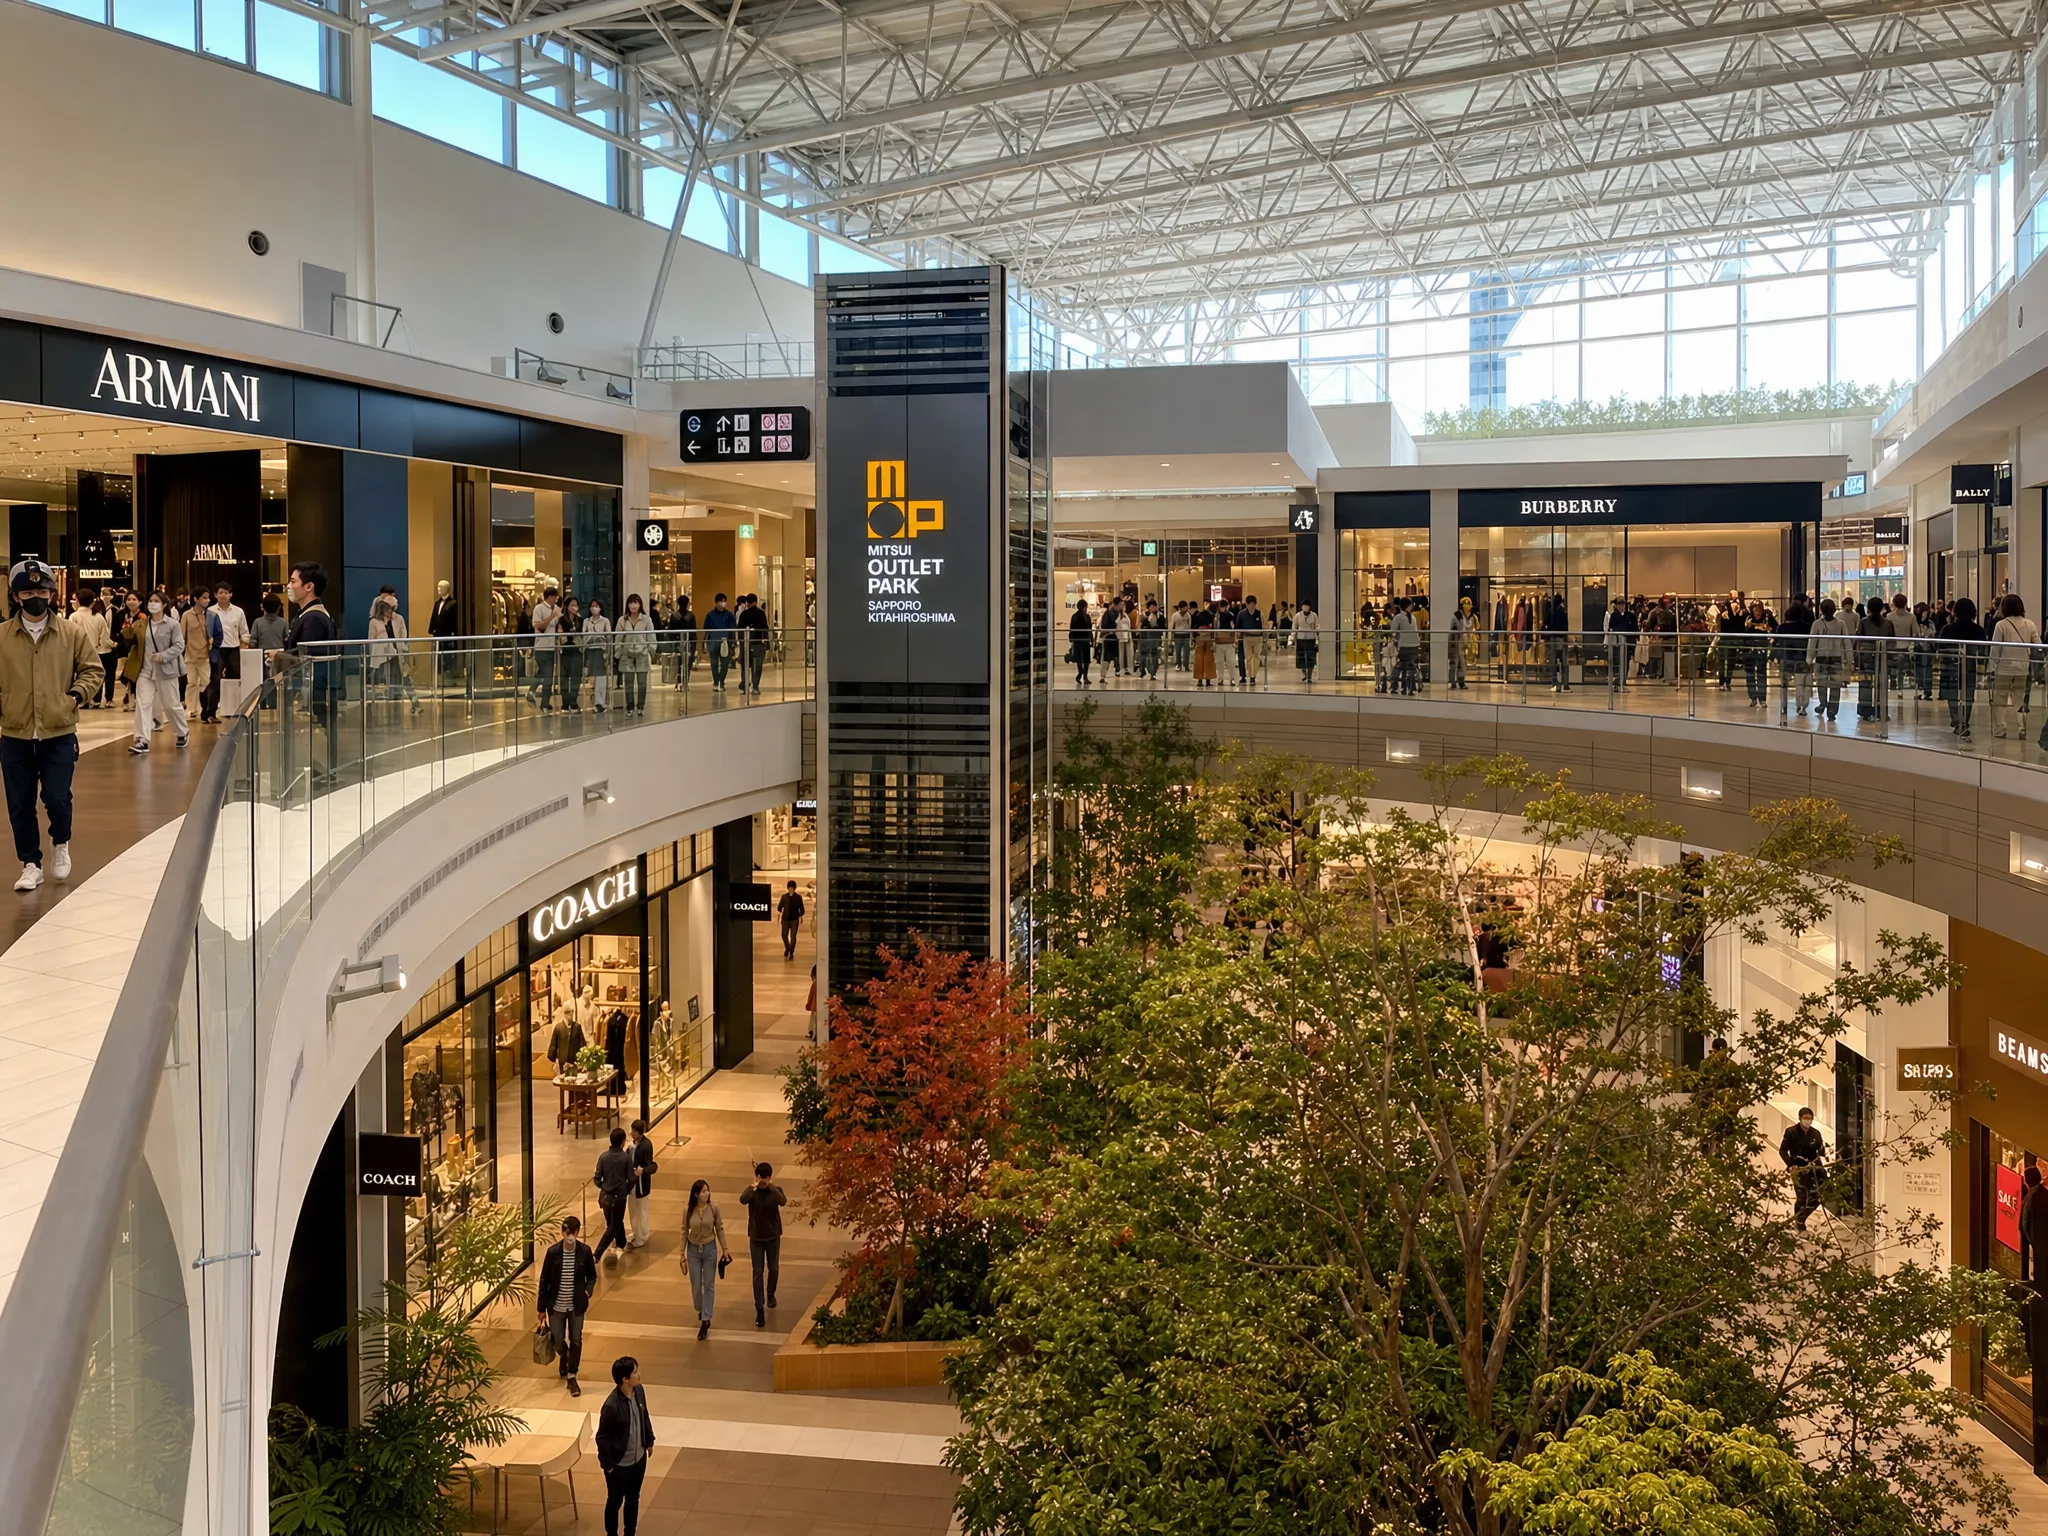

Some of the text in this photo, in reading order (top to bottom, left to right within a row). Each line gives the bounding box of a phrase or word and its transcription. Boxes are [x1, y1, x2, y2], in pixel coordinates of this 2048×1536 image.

[91, 346, 261, 422] ARMANI
[1955, 488, 1991, 497] BALLY
[1520, 499, 1618, 515] BURBERRY
[192, 543, 233, 561] ARMANI
[867, 545, 912, 557] MITSUI
[867, 558, 944, 576] OUTLET
[867, 578, 920, 595] PARK
[867, 600, 922, 611] SAPPORO
[867, 612, 956, 623] KITAHIROSHIMA
[532, 864, 639, 944] COACH
[733, 902, 768, 912] COACH
[1998, 1032, 2048, 1075] BEAMS
[362, 1174, 416, 1188] COACH
